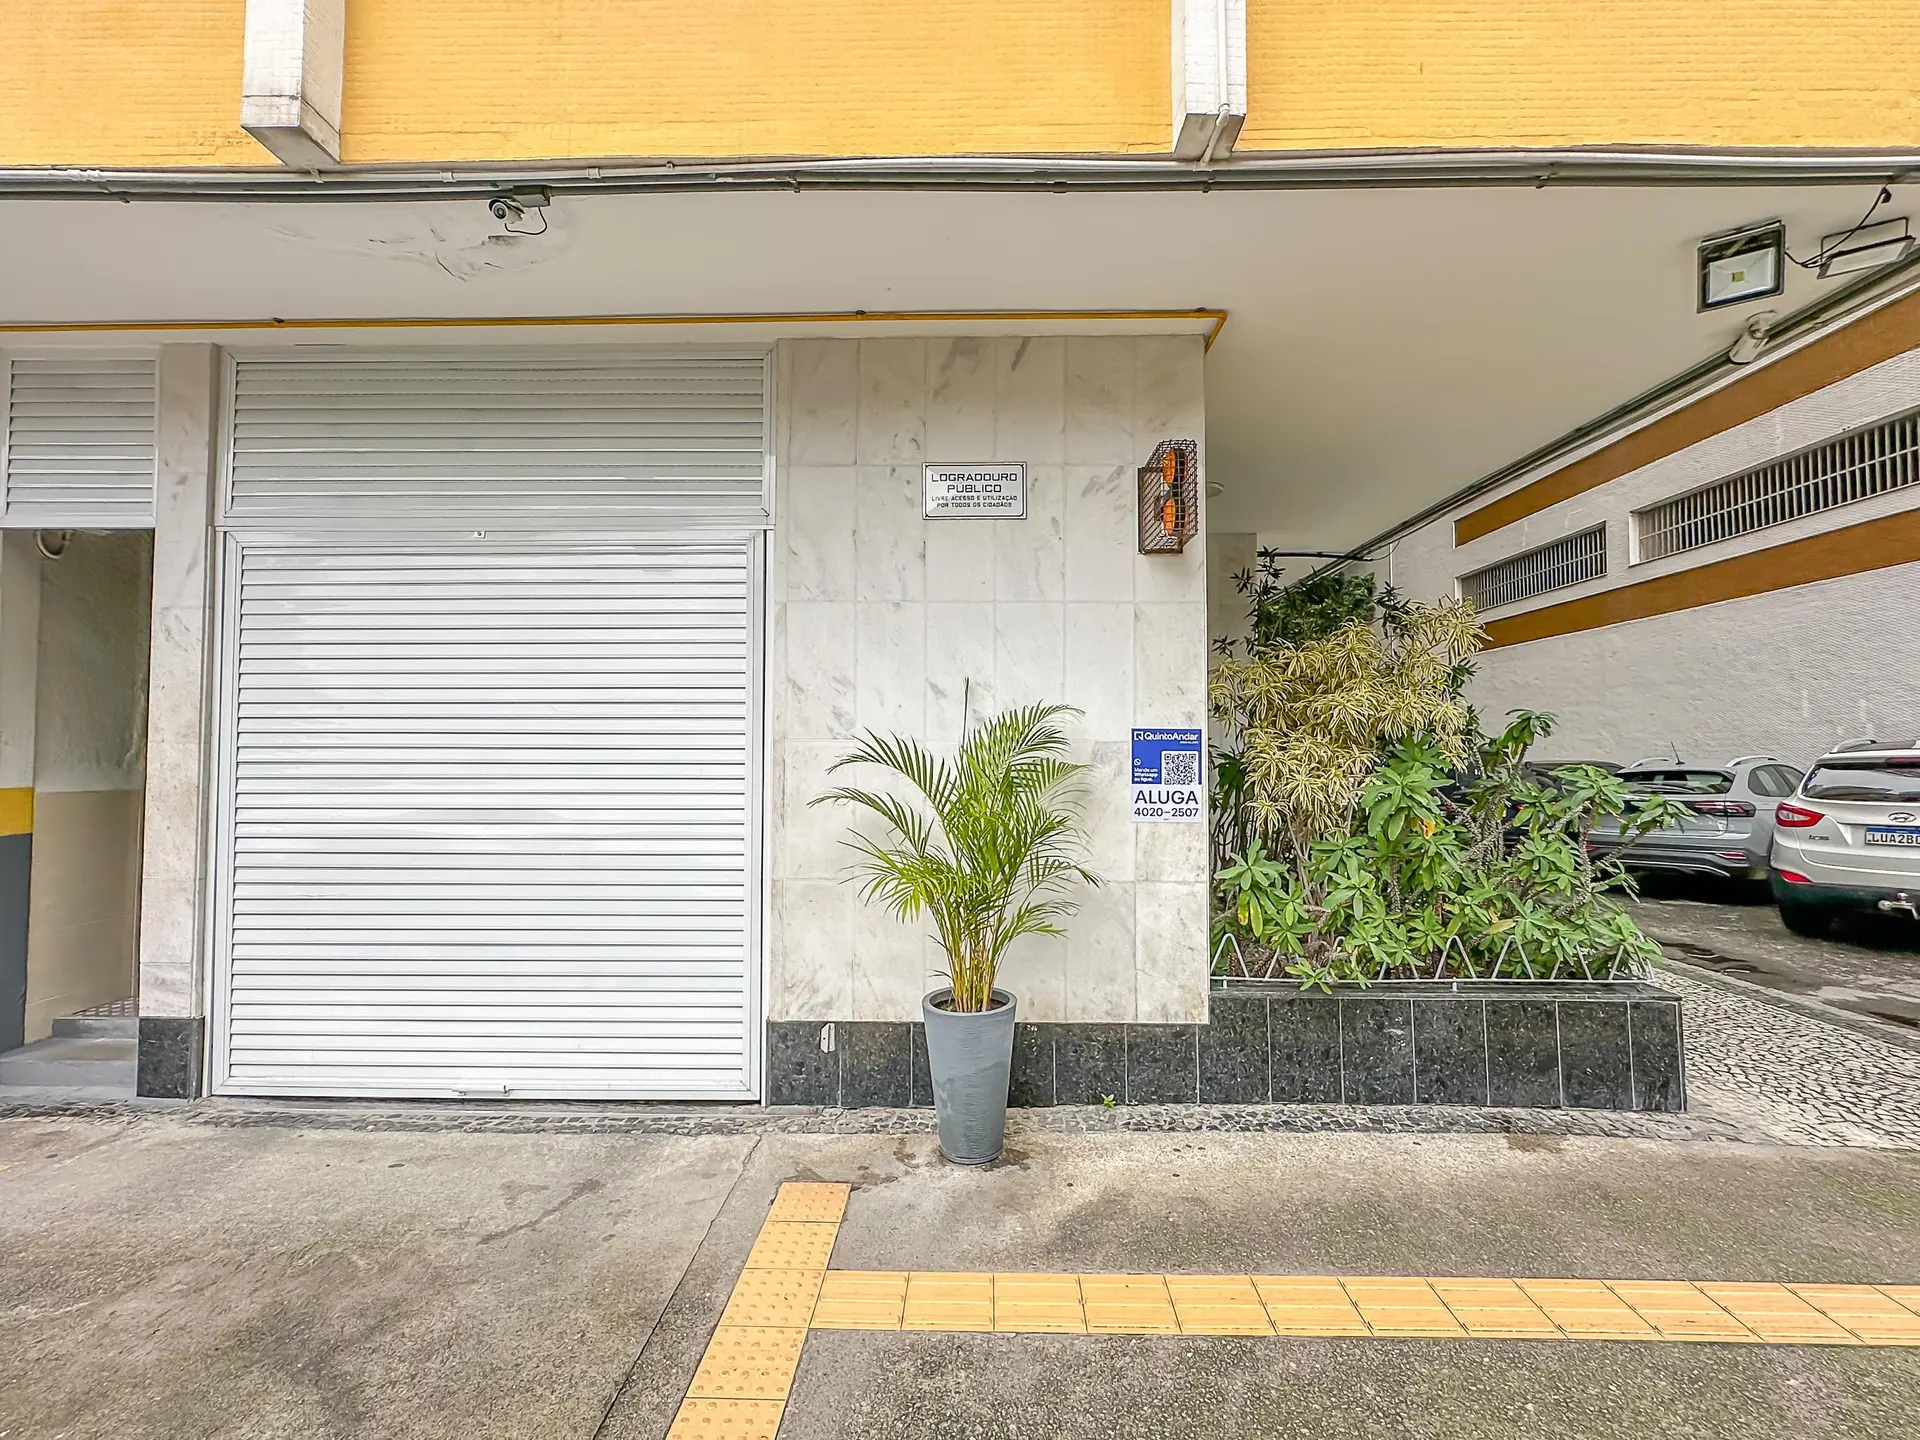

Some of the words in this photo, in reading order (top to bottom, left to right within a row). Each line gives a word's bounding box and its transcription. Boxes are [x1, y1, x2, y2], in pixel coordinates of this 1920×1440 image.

[931, 473, 1018, 482] LOGRADOURO
[1144, 732, 1199, 741] QuintoAndar
[1134, 790, 1199, 804] ALUGA
[1134, 807, 1199, 817] 4020-2507
